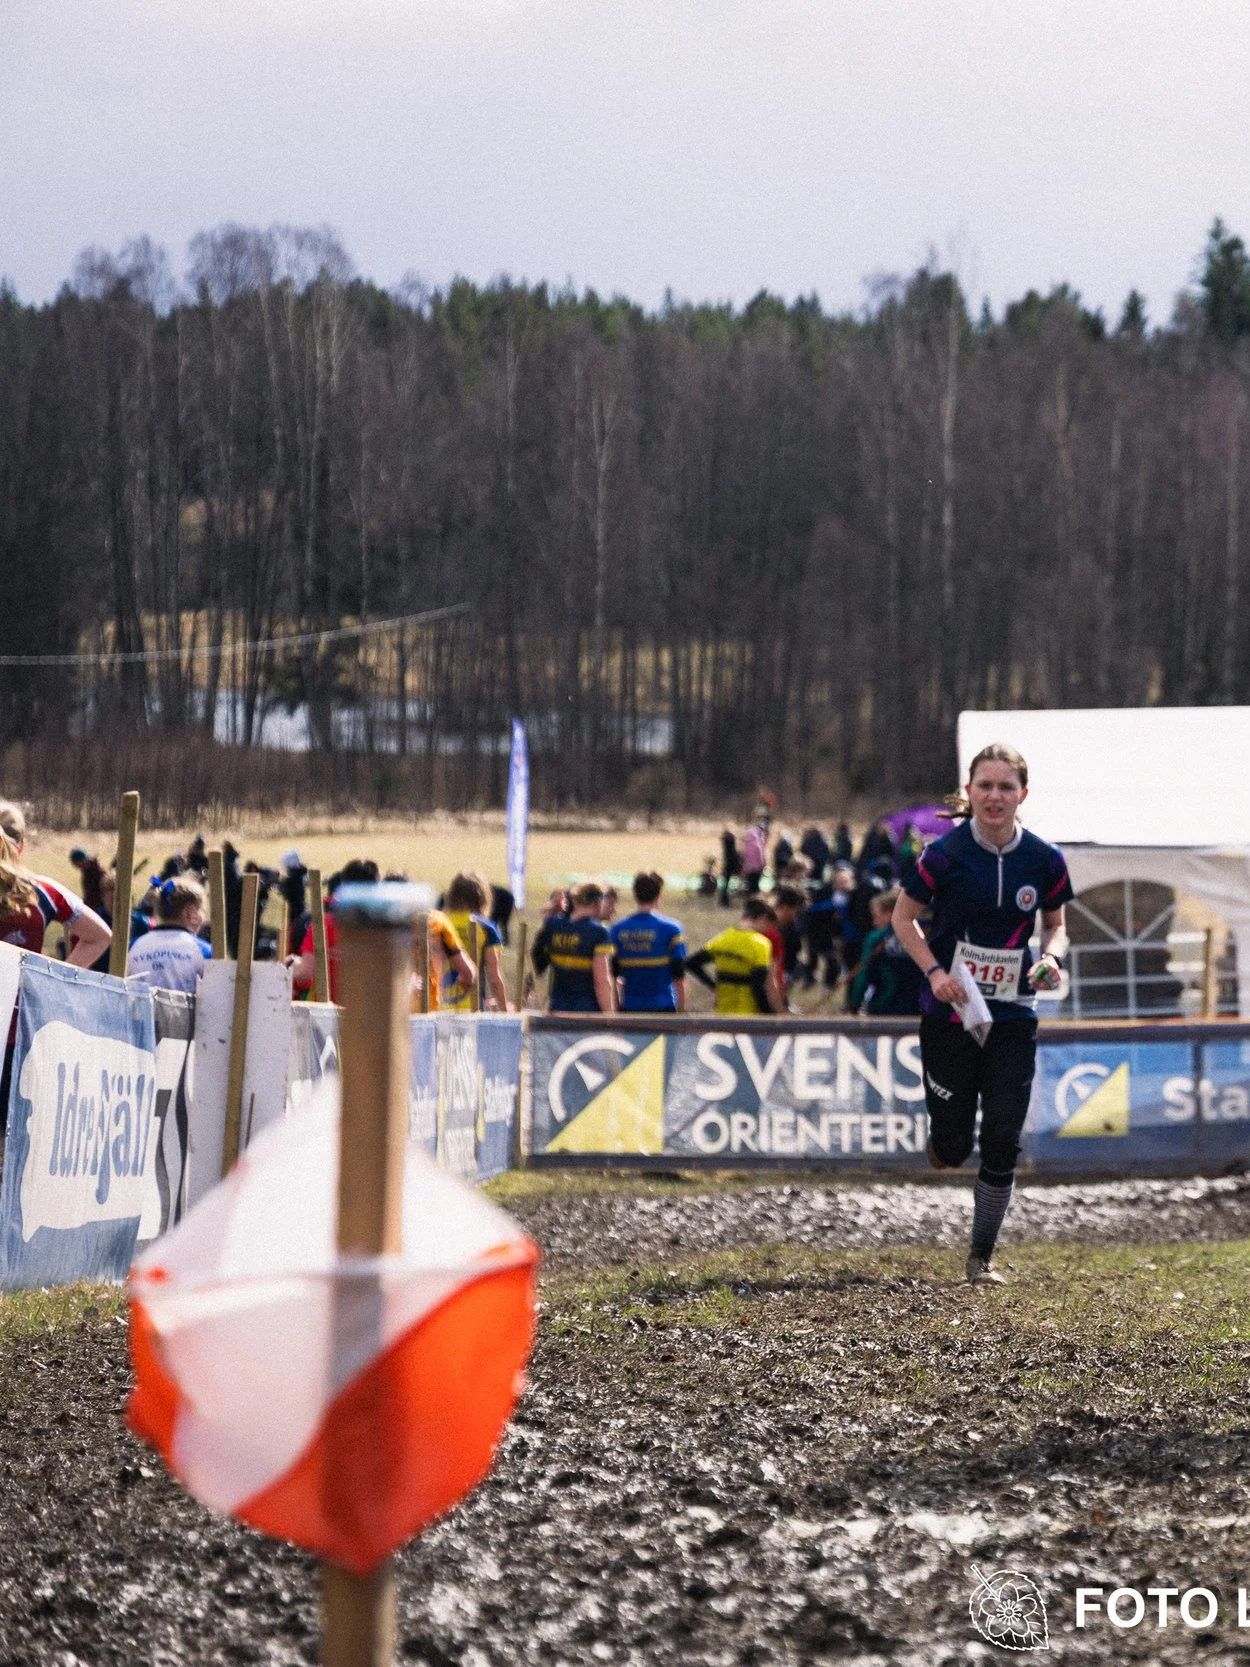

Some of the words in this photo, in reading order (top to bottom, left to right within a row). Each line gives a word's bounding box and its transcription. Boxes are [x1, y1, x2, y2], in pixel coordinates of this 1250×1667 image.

[695, 1031, 925, 1102] SVENS
[49, 1060, 155, 1205] Idrefjäll
[691, 1111, 927, 1155] ORIENTERI
